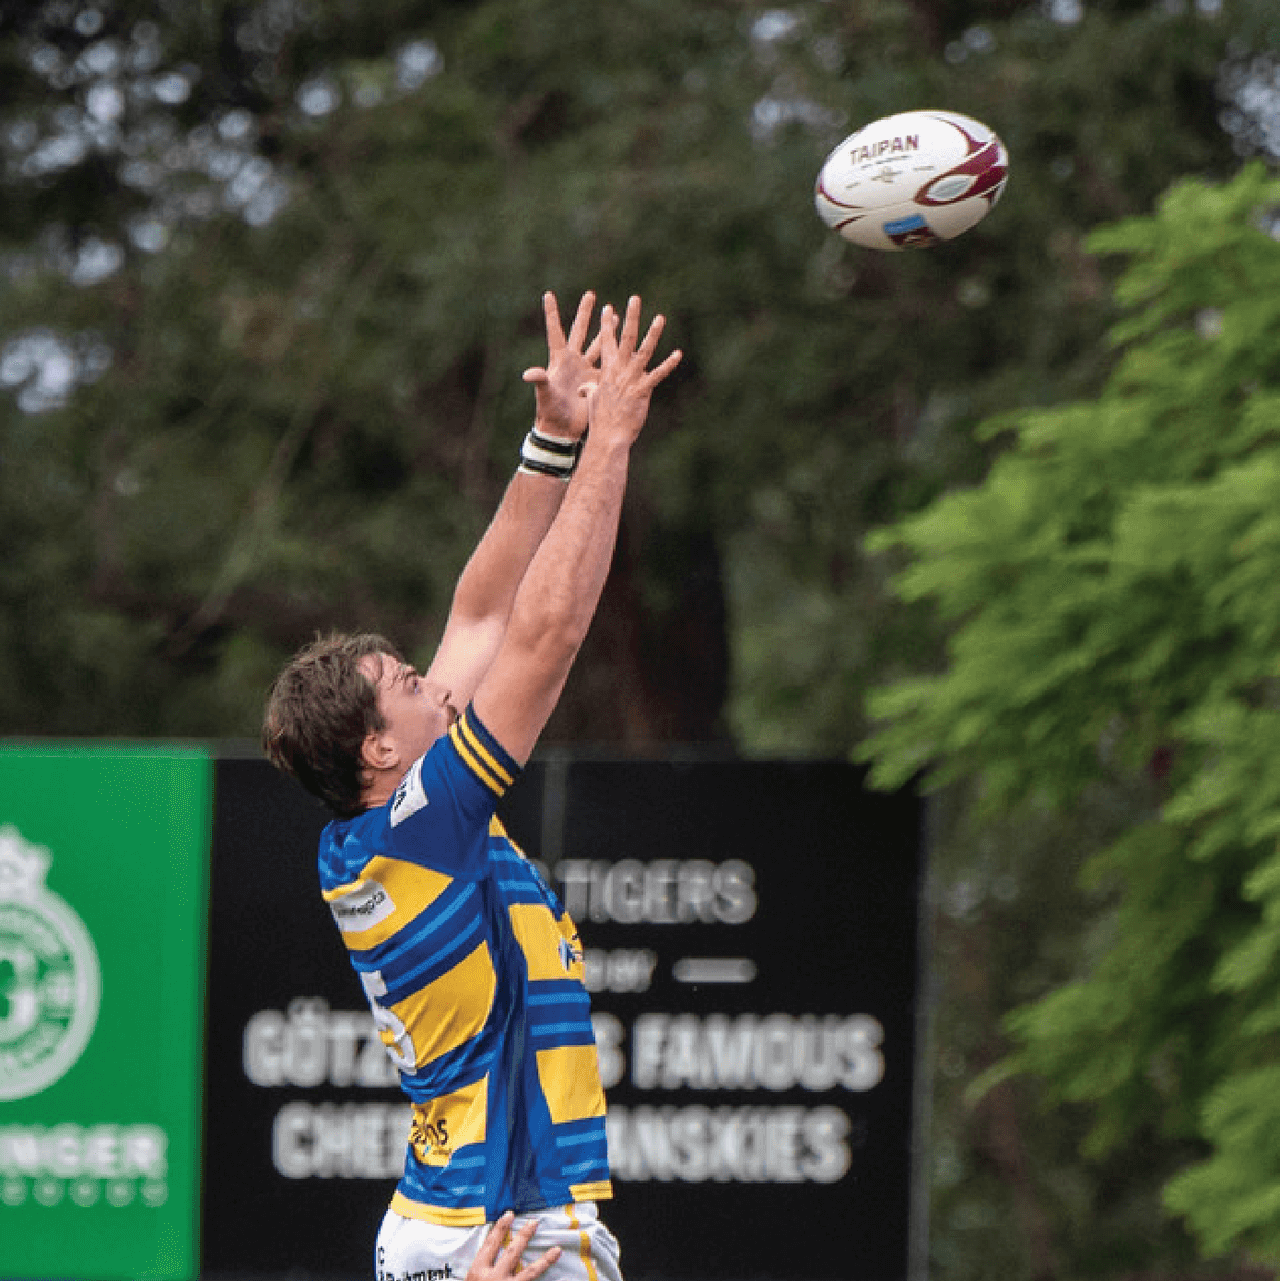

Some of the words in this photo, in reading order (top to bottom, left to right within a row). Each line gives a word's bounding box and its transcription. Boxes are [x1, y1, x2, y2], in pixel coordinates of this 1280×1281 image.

[850, 133, 920, 165] TAIPAN
[556, 858, 758, 924] TIGERS
[631, 1011, 886, 1091] FAMOUS
[604, 1104, 854, 1184] ANSKIES
